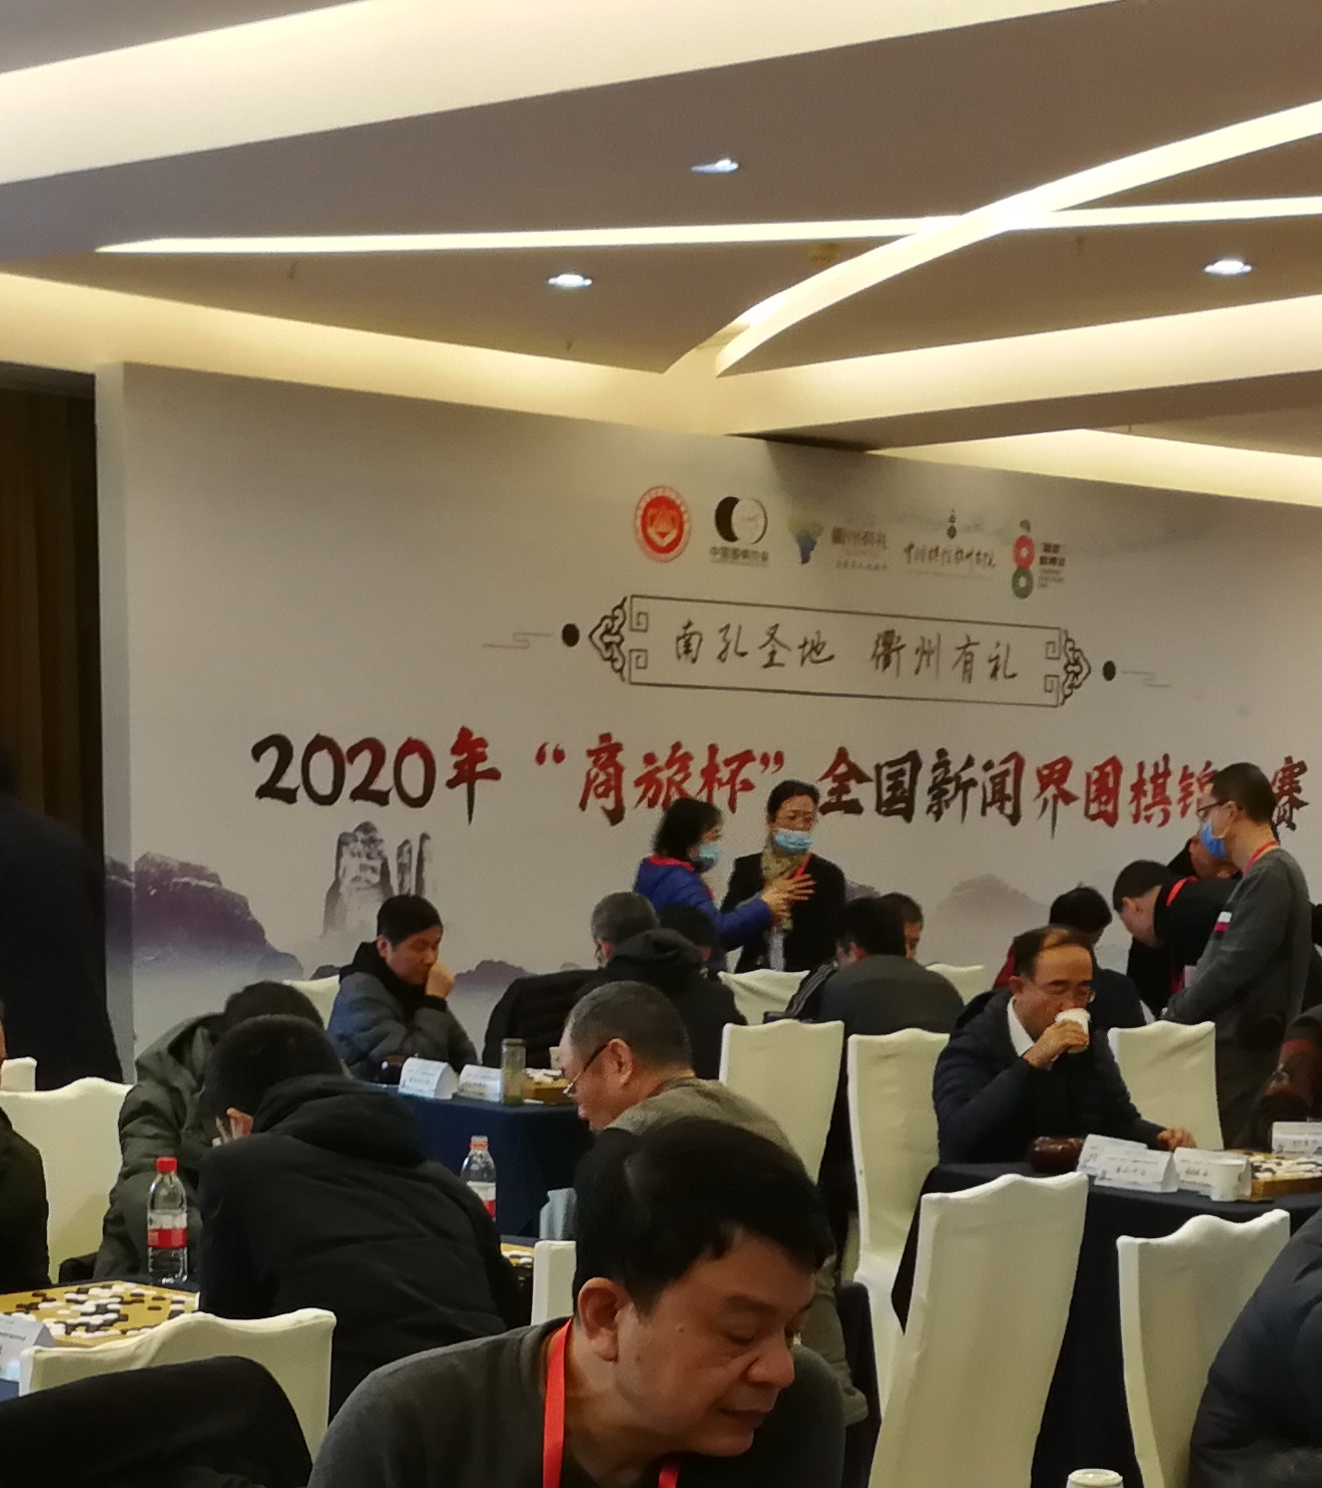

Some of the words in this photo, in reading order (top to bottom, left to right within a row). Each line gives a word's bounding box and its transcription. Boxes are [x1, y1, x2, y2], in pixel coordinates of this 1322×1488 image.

[676, 619, 836, 669] 南孔圣地
[870, 629, 1019, 684] 衢州有礼
